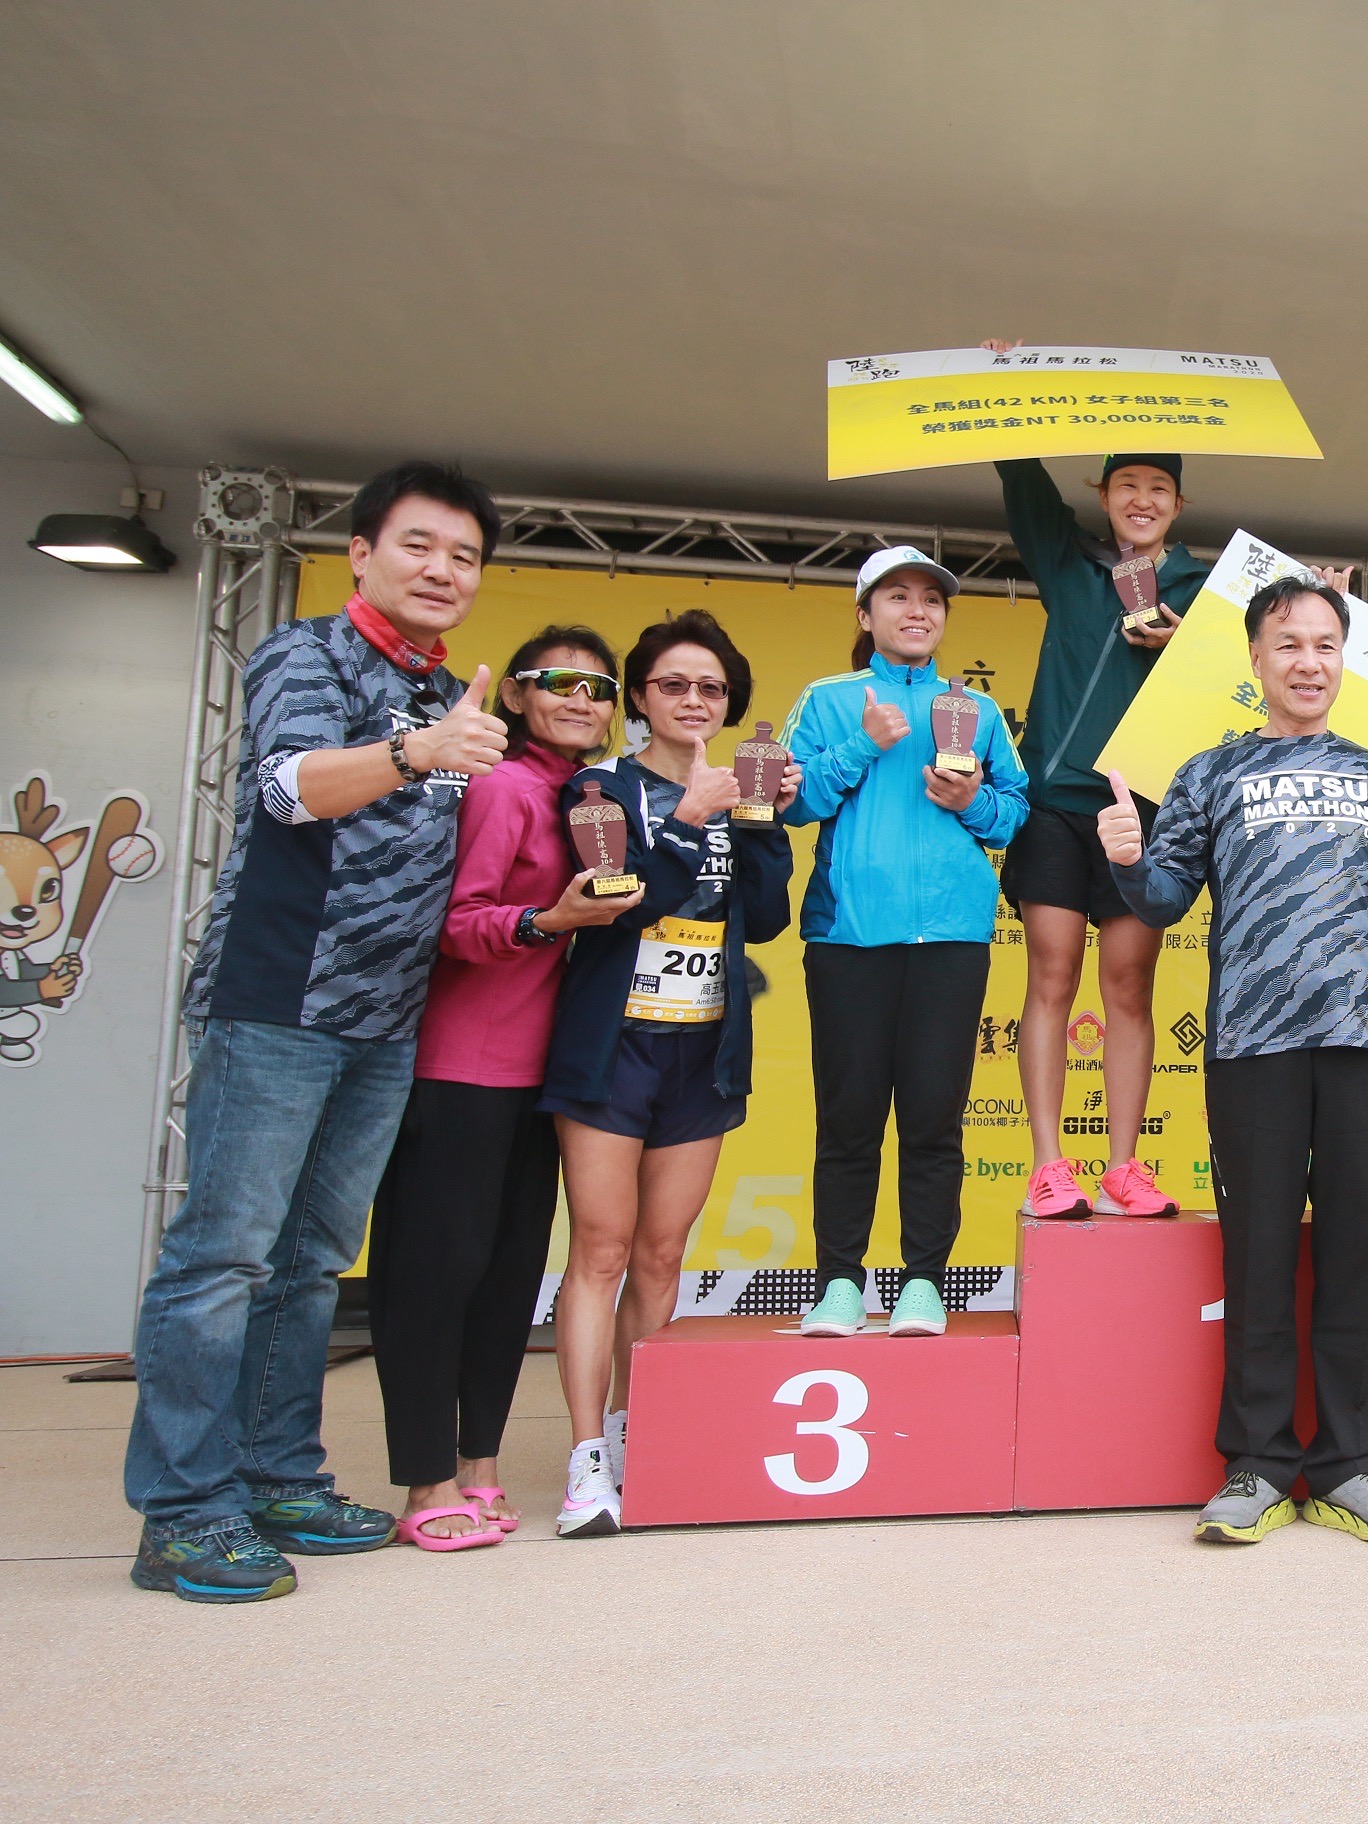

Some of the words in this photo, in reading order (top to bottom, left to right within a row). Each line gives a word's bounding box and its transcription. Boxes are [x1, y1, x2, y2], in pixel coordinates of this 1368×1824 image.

[992, 356, 1118, 366] 馬祖馬拉松
[1180, 355, 1258, 368] MATSU
[1030, 395, 1078, 407] KM)
[1085, 394, 1230, 408] 女子組第三名
[1068, 413, 1227, 426] 30,000元獎金
[1150, 1064, 1198, 1074] HAPER
[963, 1098, 1024, 1115] OCONU
[763, 1368, 870, 1496] 3
